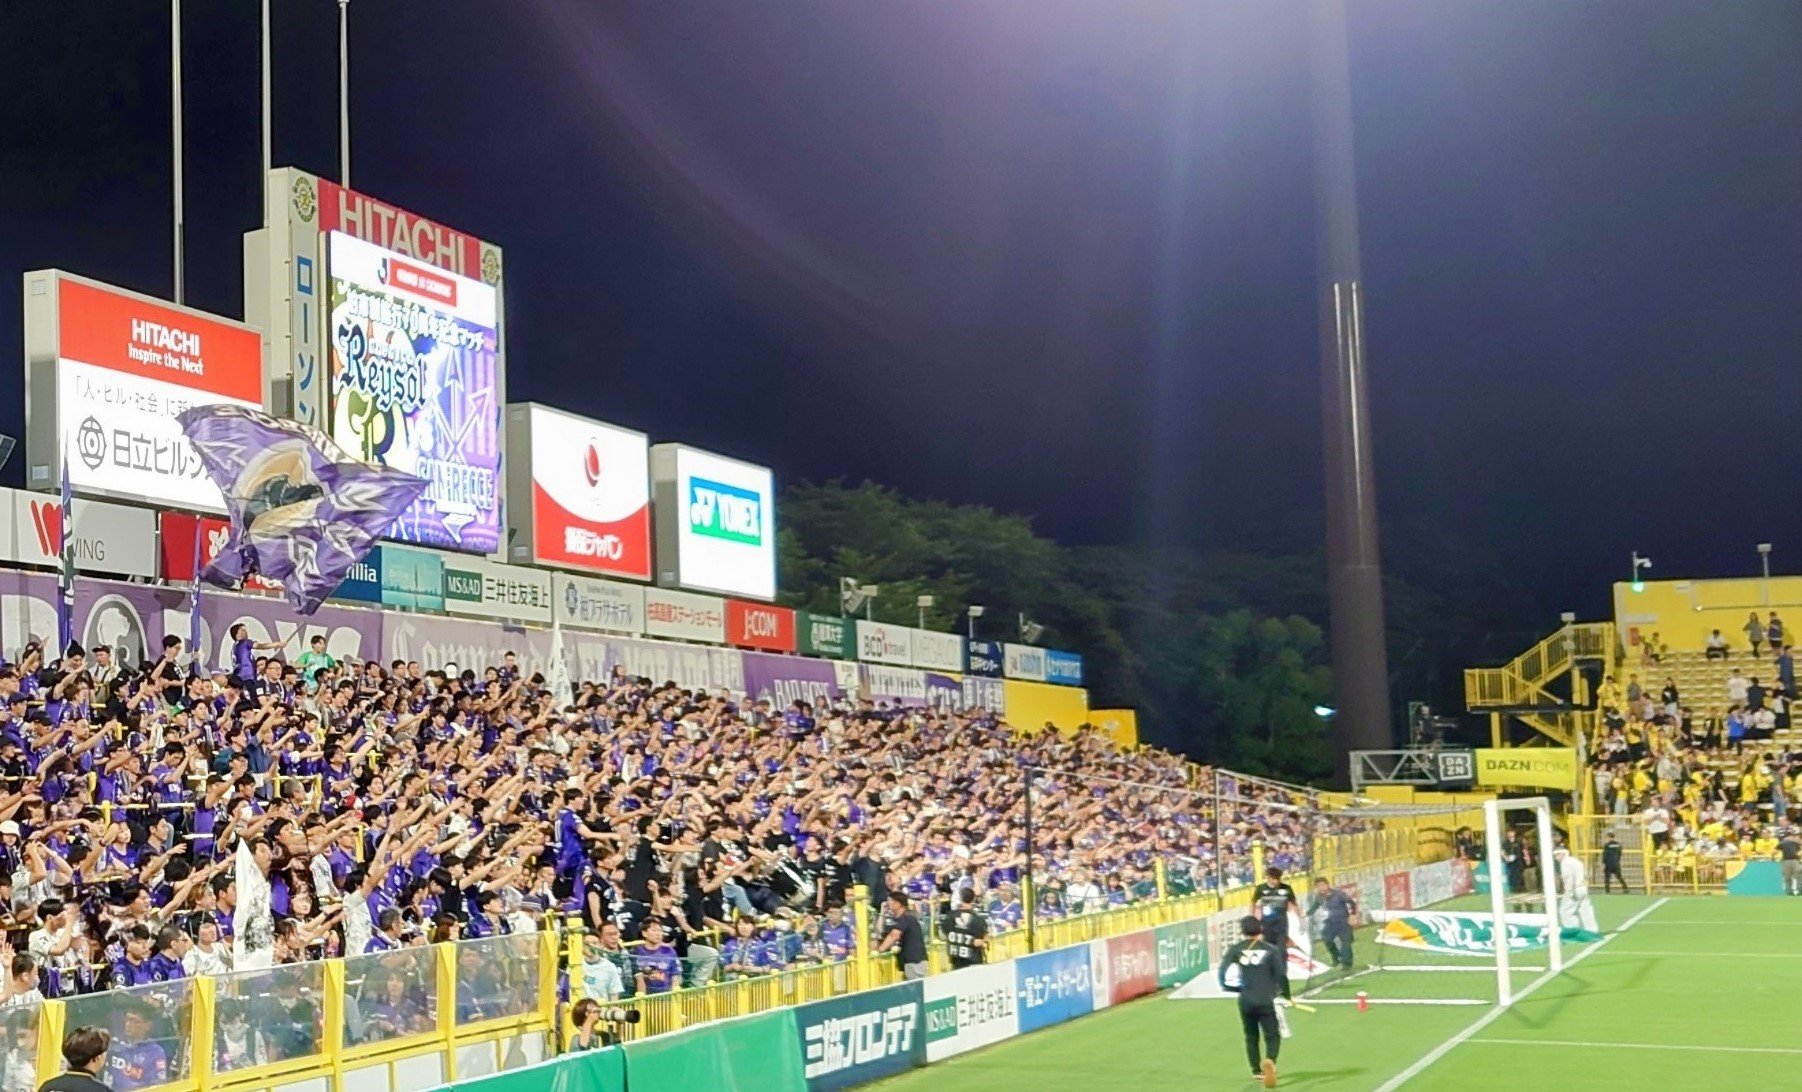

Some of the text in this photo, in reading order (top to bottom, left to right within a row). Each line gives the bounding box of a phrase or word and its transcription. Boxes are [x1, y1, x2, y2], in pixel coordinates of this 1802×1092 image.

[338, 190, 465, 275] HITACHI
[132, 318, 199, 357] HITACHI
[128, 343, 203, 376] Inspire the Next
[337, 322, 428, 410] Reysol
[76, 375, 194, 416] 「人・ビル・社会」に新
[112, 428, 208, 480] 日立ビルシ
[716, 491, 760, 538] YONEX
[447, 575, 549, 609] MS&AD 三井住友海上
[864, 634, 882, 658] BCD
[1445, 756, 1464, 766] DA
[1446, 766, 1465, 776] ZN
[926, 985, 1013, 1033] MS&AD 三井住友海上
